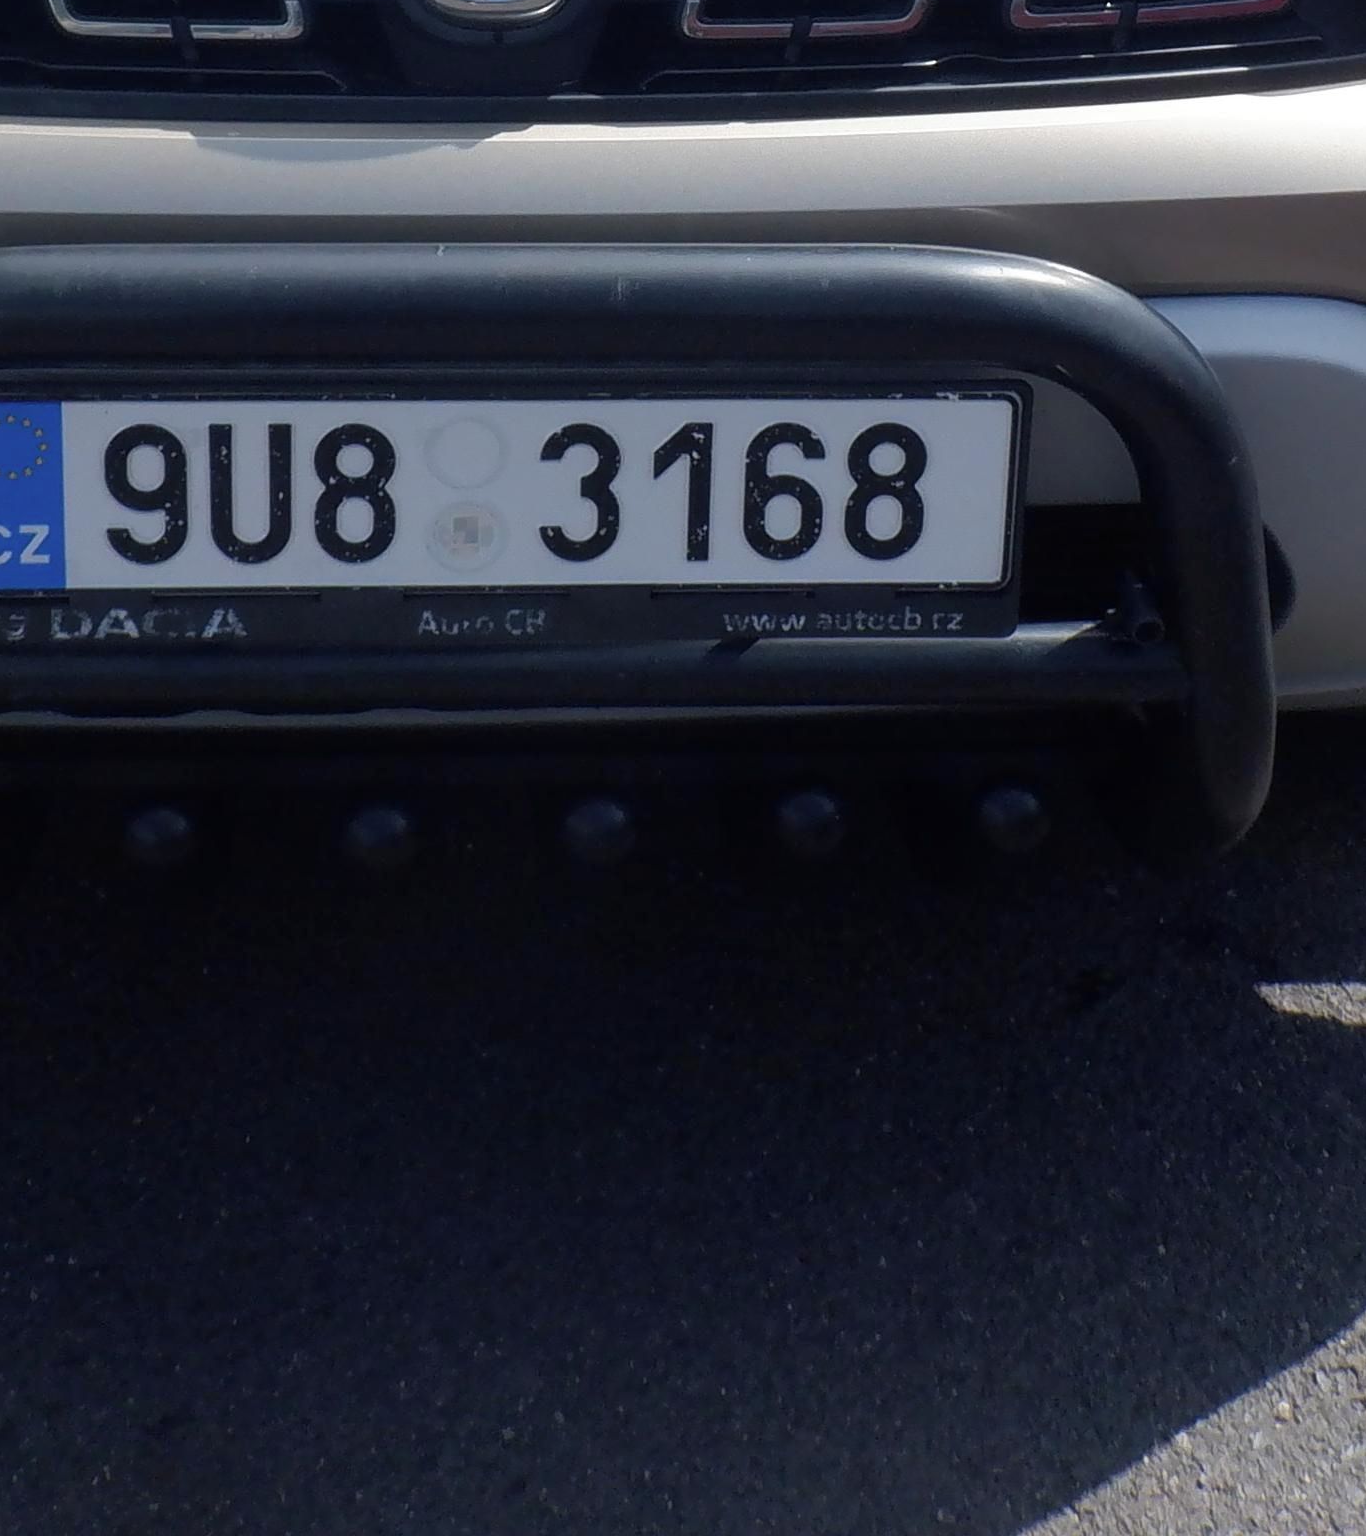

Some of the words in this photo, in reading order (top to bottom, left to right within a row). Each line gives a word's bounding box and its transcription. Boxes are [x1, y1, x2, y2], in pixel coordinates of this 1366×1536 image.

[104, 422, 398, 564] 9U8
[539, 421, 928, 563] 3168
[49, 607, 249, 640] DACA
